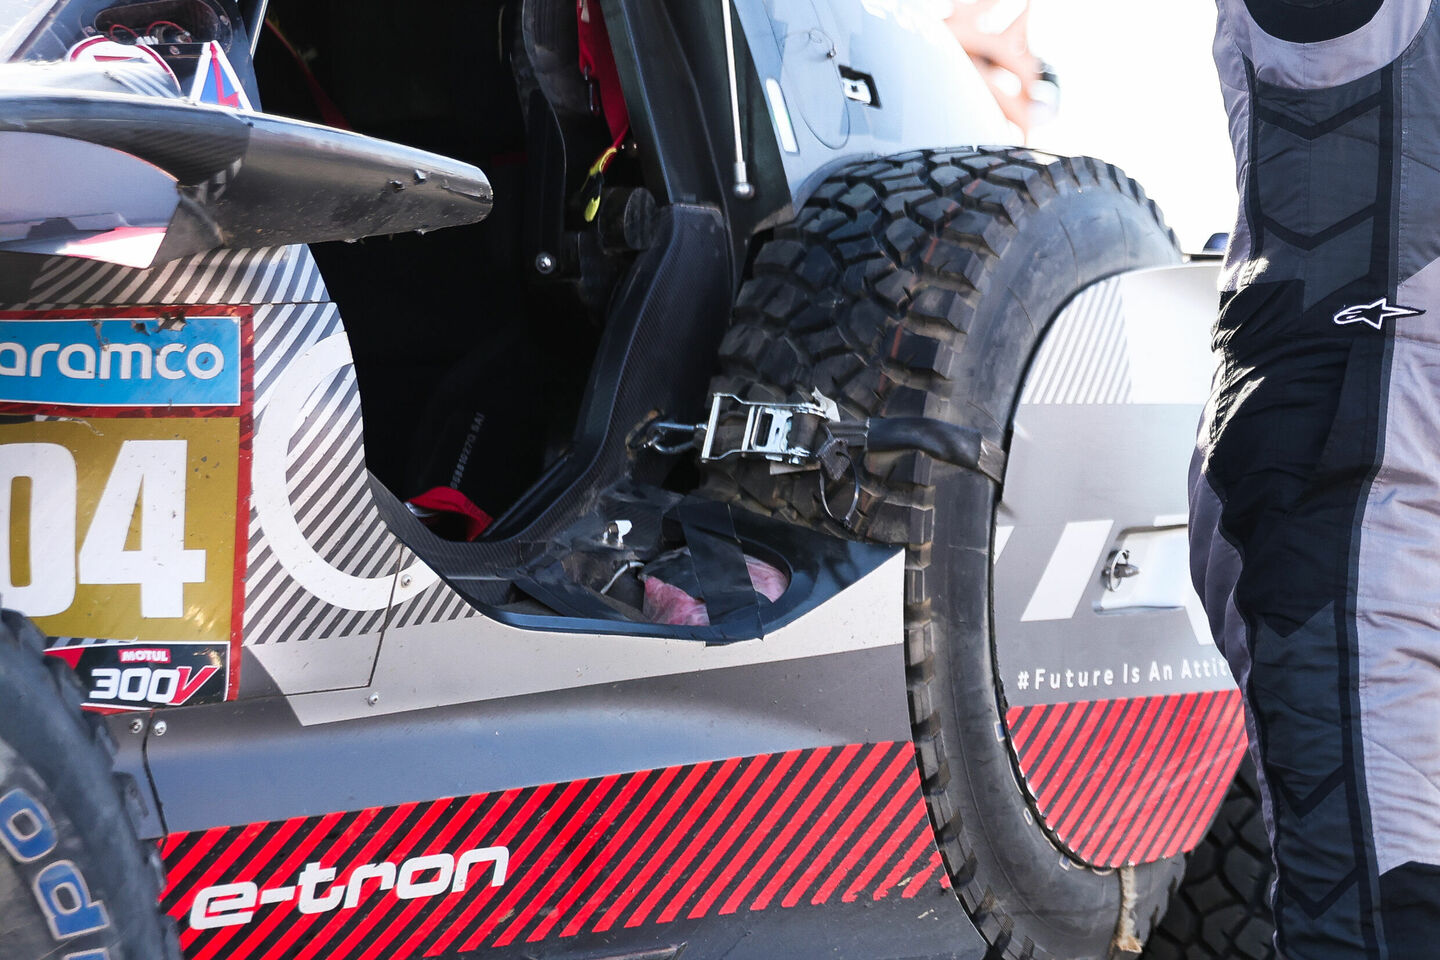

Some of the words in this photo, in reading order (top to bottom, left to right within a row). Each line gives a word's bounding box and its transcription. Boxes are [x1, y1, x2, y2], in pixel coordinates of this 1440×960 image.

[0, 341, 225, 381] aramco
[0, 439, 207, 619] 04
[120, 649, 169, 662] MOTUL
[1017, 668, 1114, 690] #Future
[1123, 663, 1140, 684] Is
[1149, 660, 1173, 682] An
[1181, 657, 1228, 680] Attit
[88, 665, 222, 706] 300V
[189, 845, 510, 930] e-tron
